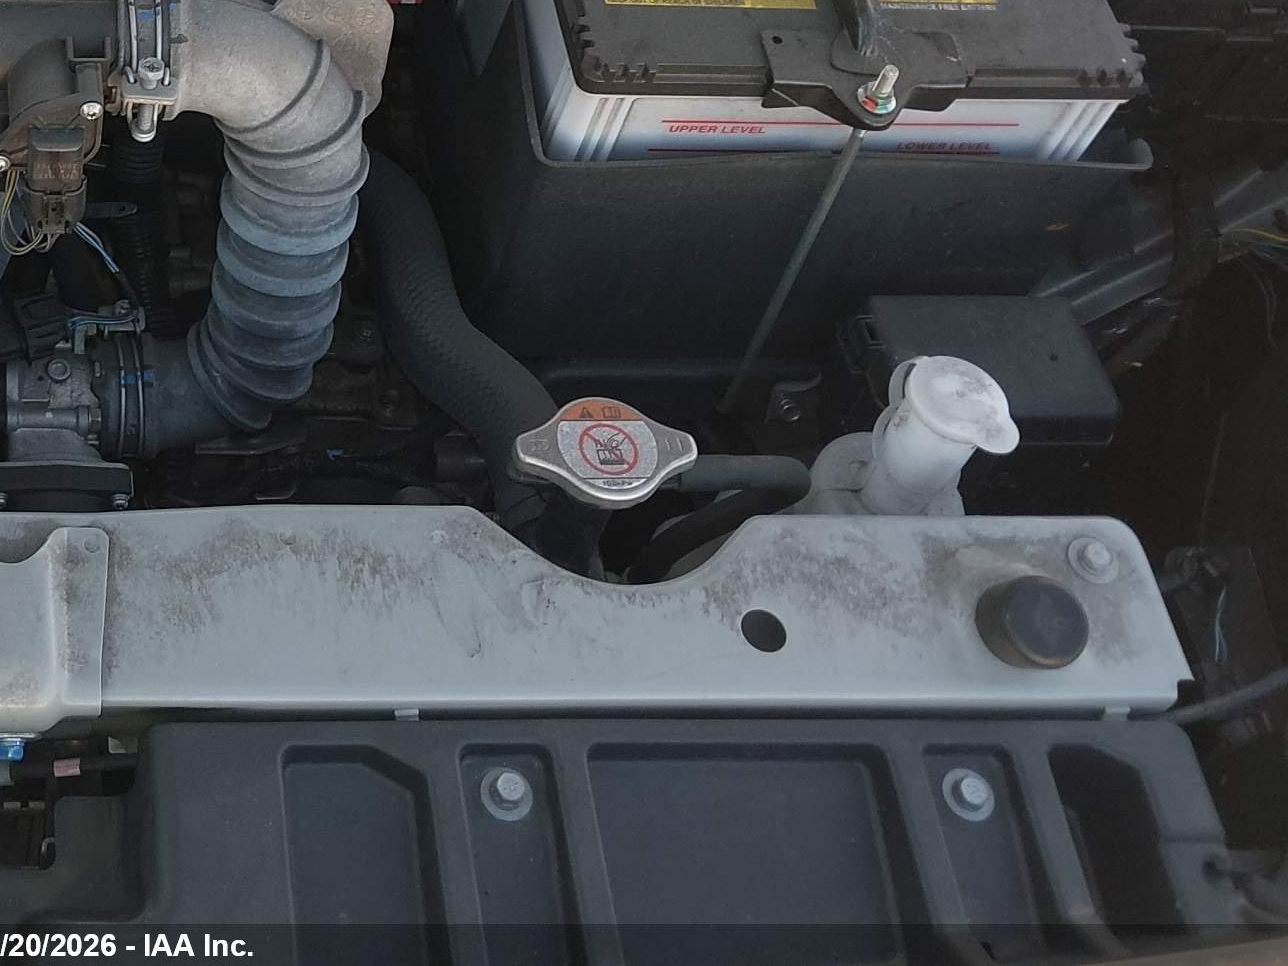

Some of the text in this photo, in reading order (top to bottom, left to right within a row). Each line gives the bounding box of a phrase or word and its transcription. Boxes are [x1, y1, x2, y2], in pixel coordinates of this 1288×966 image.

[668, 124, 767, 134] UPPER LEVEL
[895, 141, 992, 151] LOWER LEVEL
